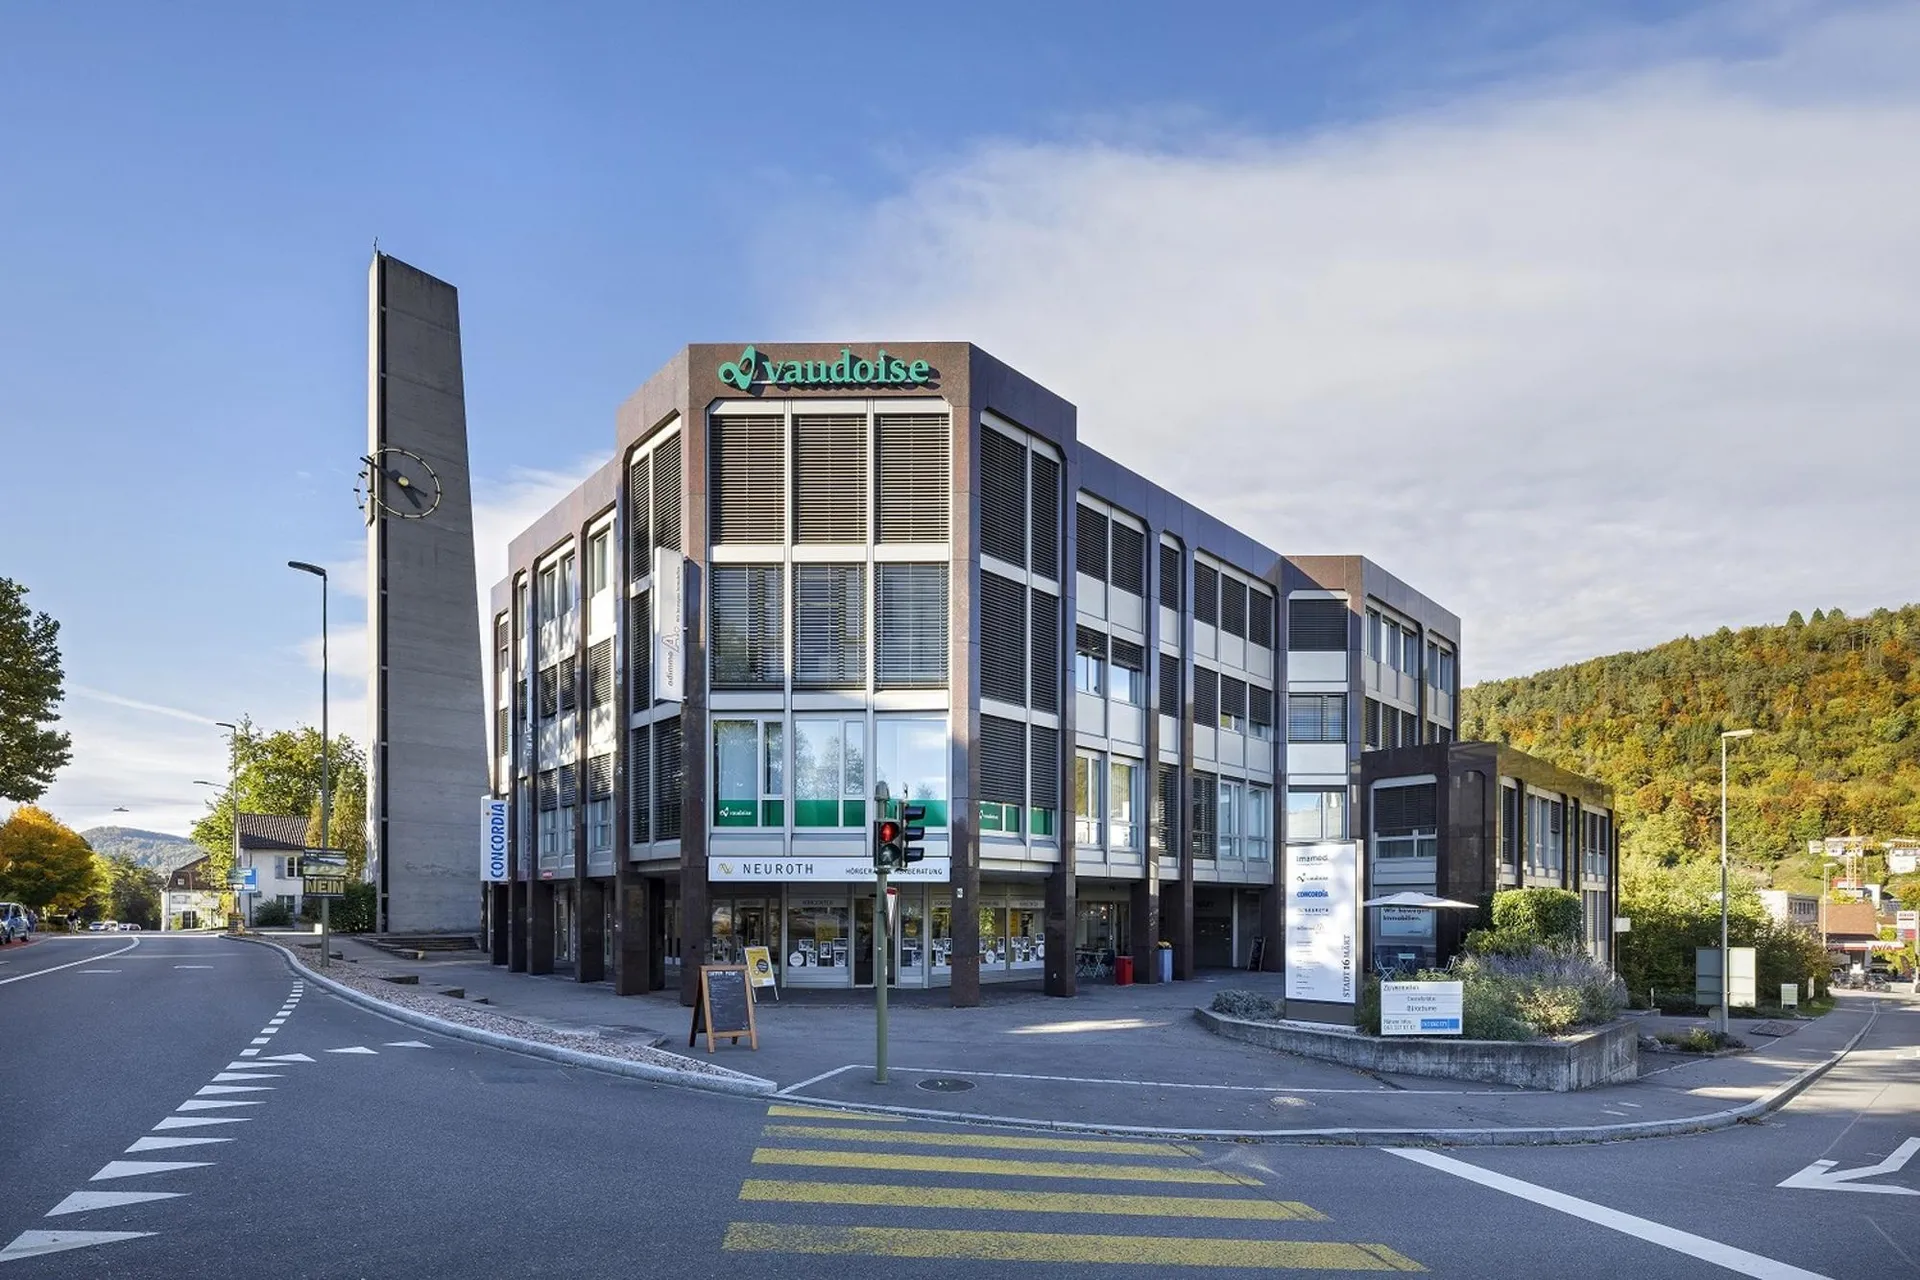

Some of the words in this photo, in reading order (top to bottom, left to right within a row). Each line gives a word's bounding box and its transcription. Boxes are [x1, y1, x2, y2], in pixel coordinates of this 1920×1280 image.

[762, 349, 930, 385] vaudoise
[665, 651, 674, 687] adimmo
[490, 804, 504, 878] CONCORDIA
[743, 863, 814, 875] NEUROTH
[305, 880, 344, 893] NEIN
[1296, 889, 1329, 898] CONCORDIA
[1341, 959, 1350, 970] 16
[1342, 971, 1350, 998] STADT
